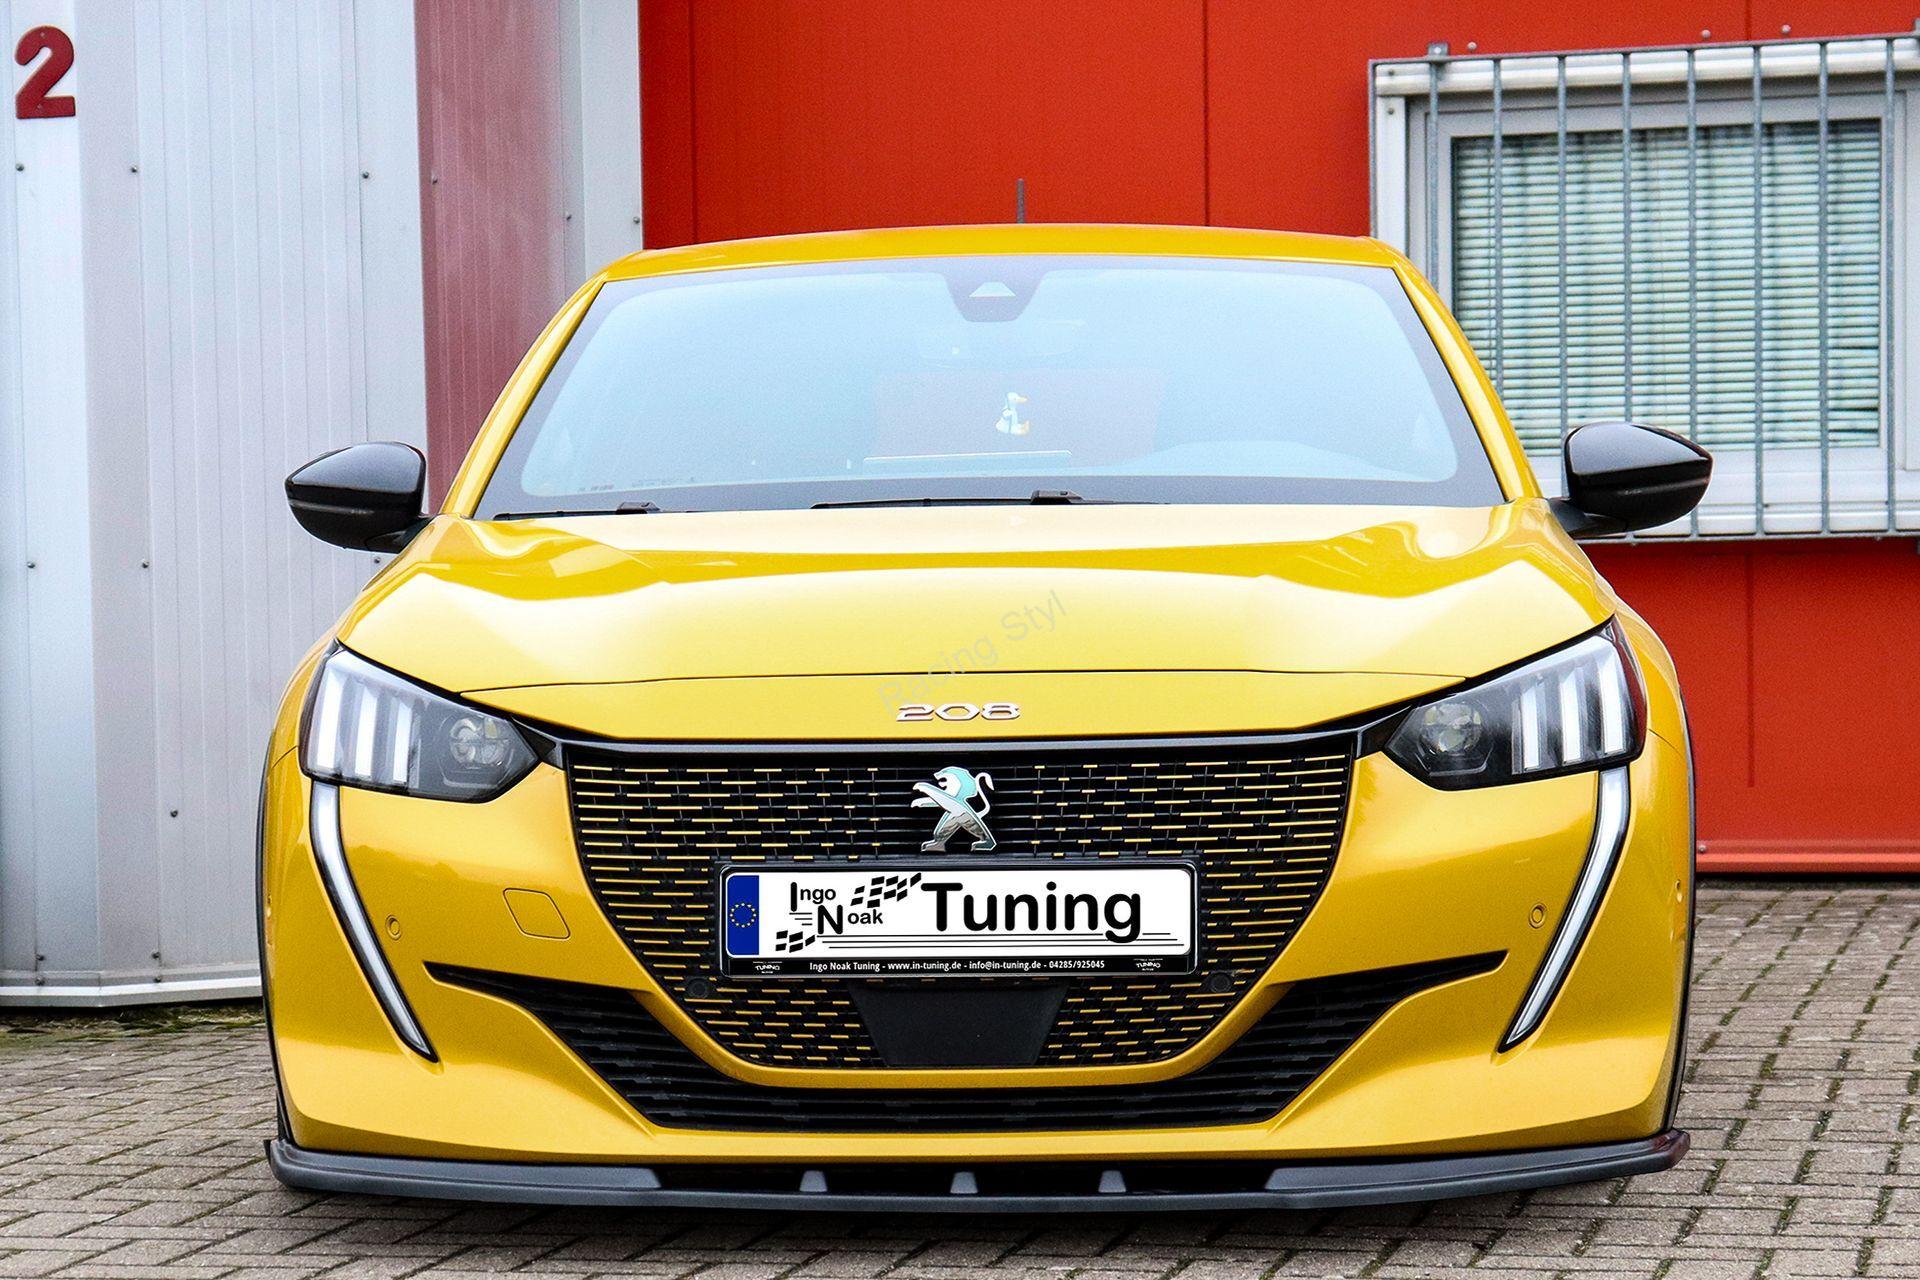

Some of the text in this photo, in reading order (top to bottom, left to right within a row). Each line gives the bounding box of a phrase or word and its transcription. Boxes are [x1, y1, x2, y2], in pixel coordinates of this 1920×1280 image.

[15, 25, 75, 119] 2
[896, 702, 1021, 722] 208
[790, 881, 836, 912] Ingo
[817, 904, 884, 935] Noak
[920, 881, 1141, 944] Tuning
[809, 962, 828, 973] Ingo
[829, 962, 851, 970] Noak
[852, 961, 880, 972] Tuning
[887, 961, 961, 972] www.in-tuning.de
[969, 960, 1042, 972] info@in-tuning.de
[1048, 960, 1105, 969] 04285/925045
